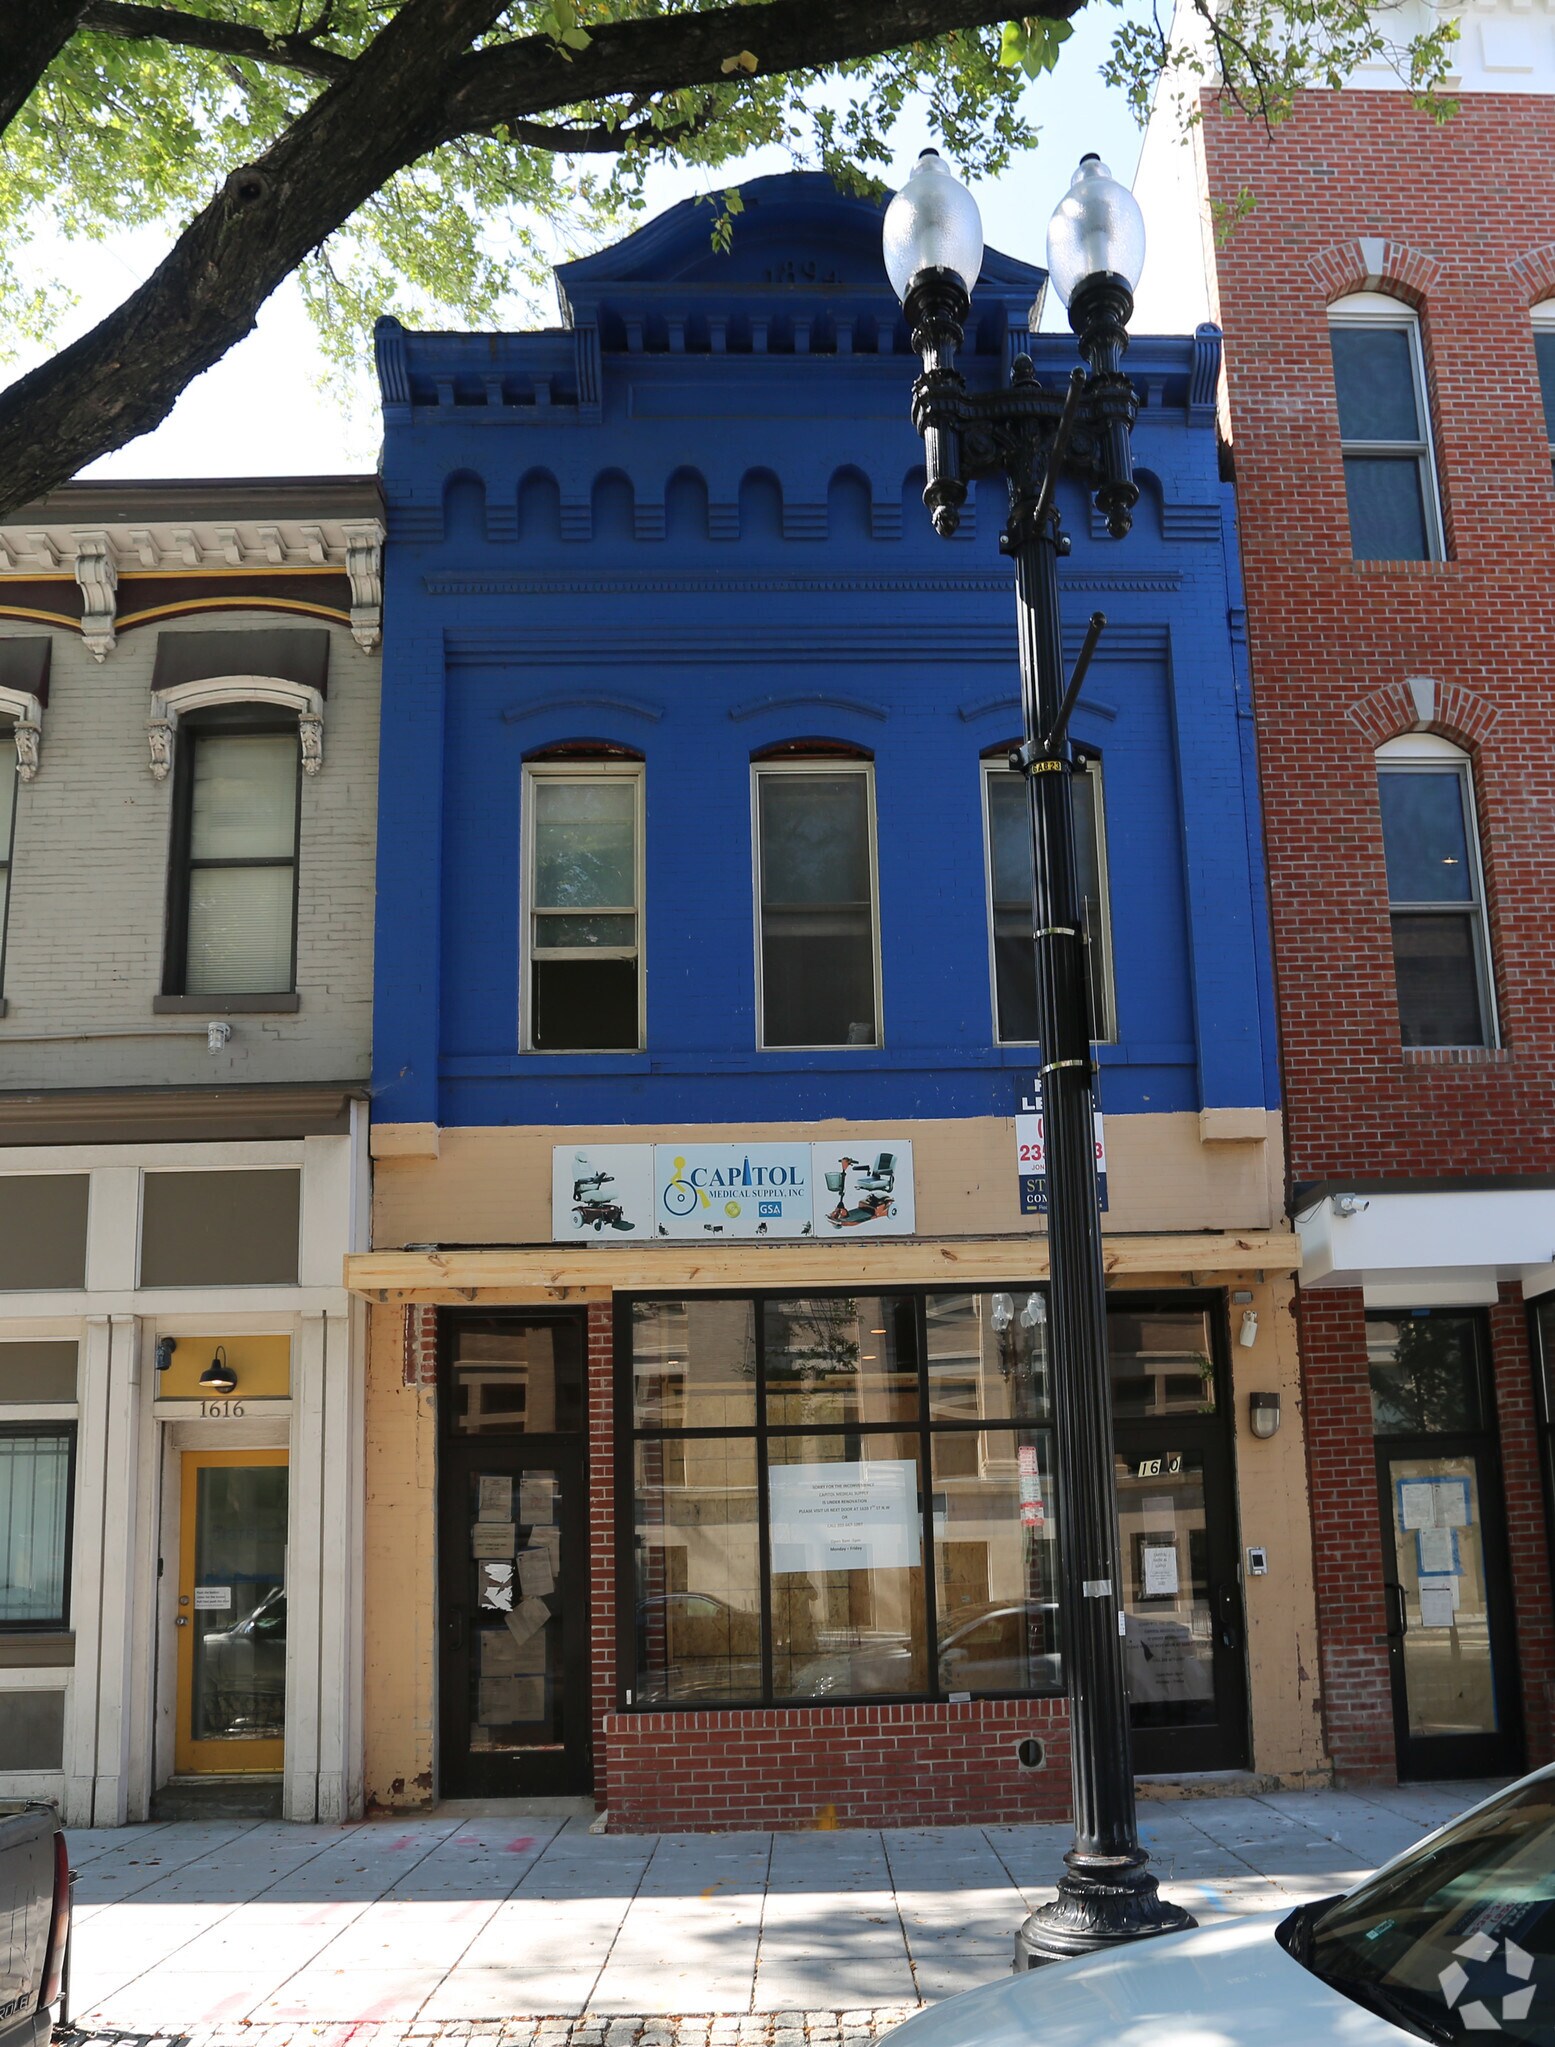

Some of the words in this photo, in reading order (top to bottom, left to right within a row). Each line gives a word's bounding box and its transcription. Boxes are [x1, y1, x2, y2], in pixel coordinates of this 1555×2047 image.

[690, 1156, 804, 1188] CAPITOL
[708, 1190, 750, 1199] MEDICAL
[752, 1189, 787, 1198] SUPPLY,
[788, 1188, 805, 1197] INC
[760, 1204, 781, 1214] GSA
[200, 1400, 244, 1418] 1616
